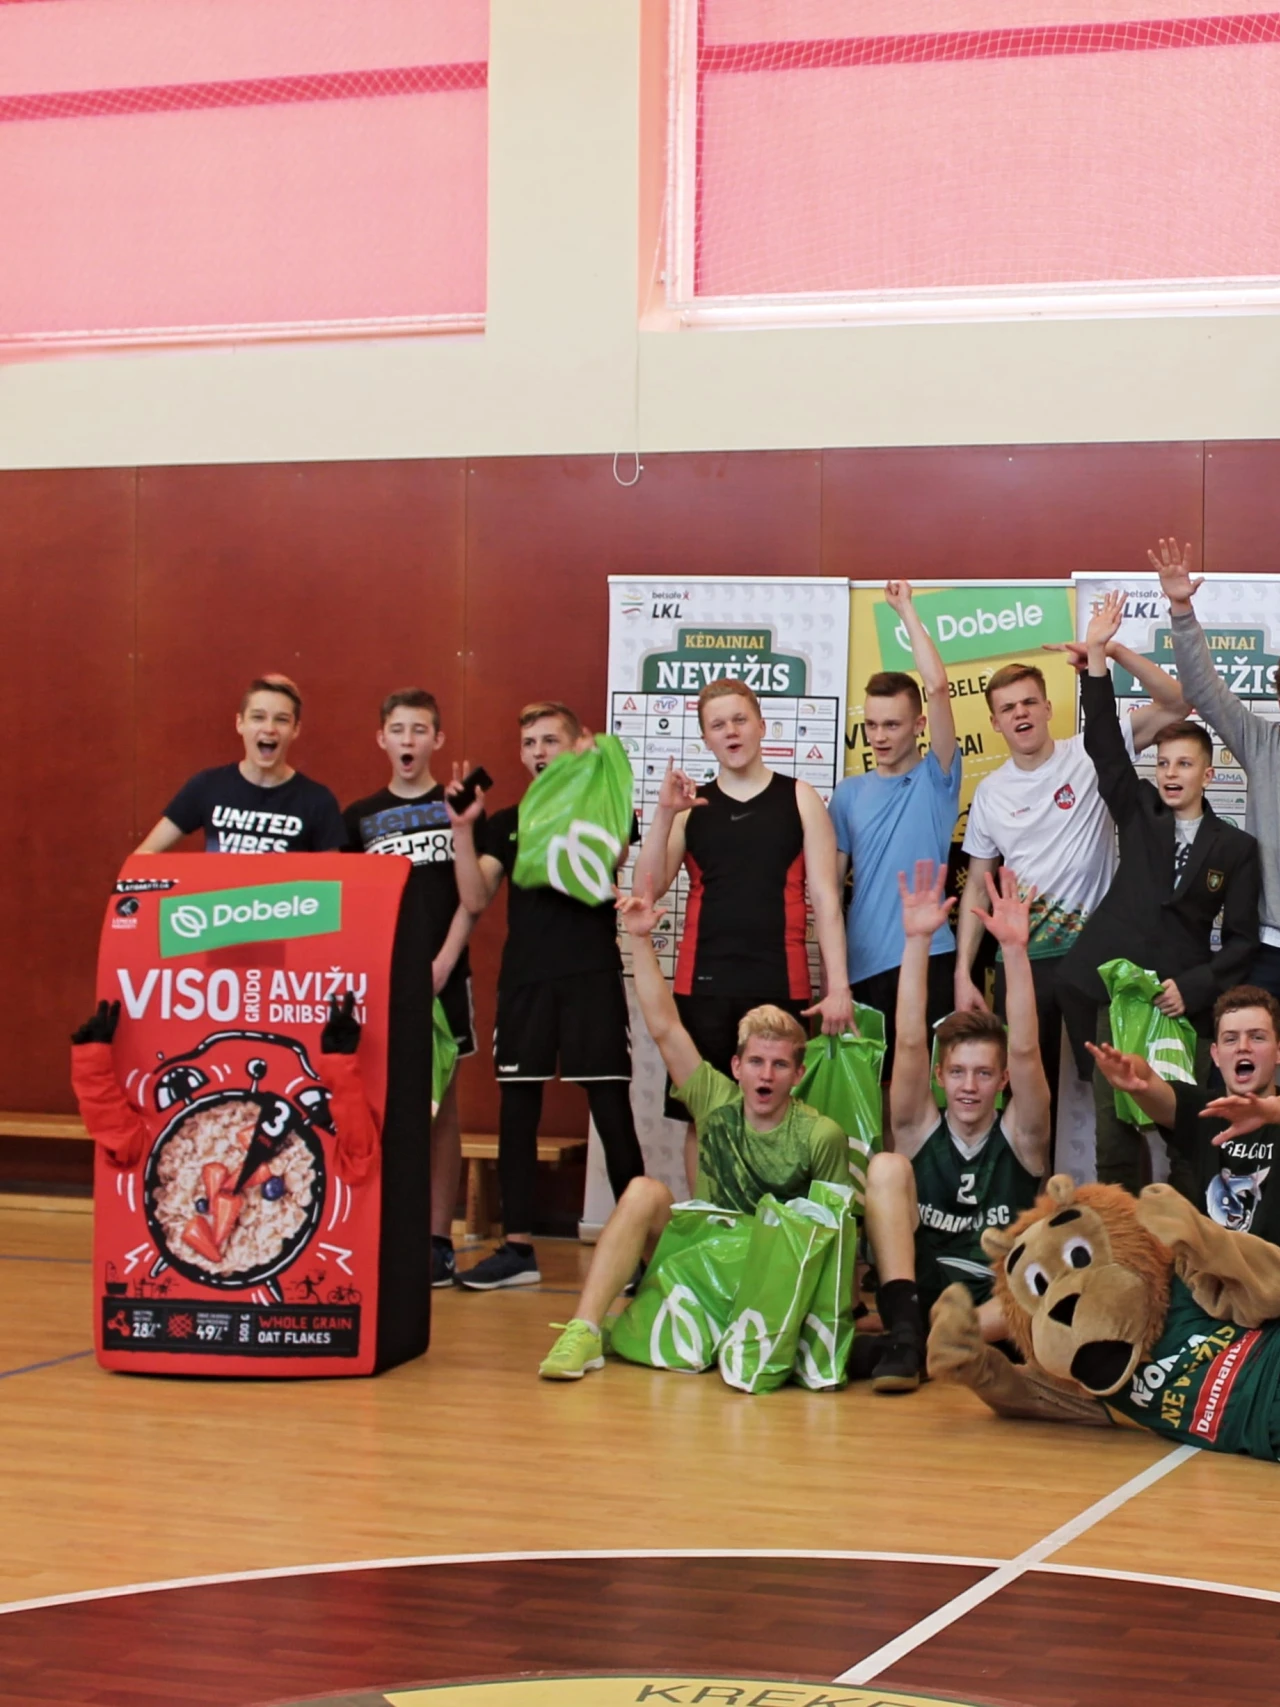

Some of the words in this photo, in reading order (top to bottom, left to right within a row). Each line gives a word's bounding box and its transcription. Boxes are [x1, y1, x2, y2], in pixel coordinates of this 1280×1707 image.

[652, 590, 682, 599] betsafe
[652, 604, 682, 619] LKL
[936, 602, 1043, 642] Dobele
[1123, 602, 1160, 619] LKL
[685, 632, 765, 650] KĖDAINIAI
[211, 805, 303, 836] UNITED
[361, 803, 449, 838] Benc
[217, 831, 289, 854] VIBES
[213, 896, 319, 927] Dobele
[117, 968, 240, 1021] VISO
[244, 969, 262, 1022] GRŪDO
[269, 966, 367, 1004] AVIŽŲ
[261, 1100, 291, 1137] 3
[956, 1173, 978, 1205] 2
[986, 1205, 1010, 1226] SC
[258, 1315, 308, 1329] WHOLE
[312, 1316, 353, 1330] GRAIN
[257, 1331, 281, 1344] OAT
[284, 1332, 331, 1344] FLAKES
